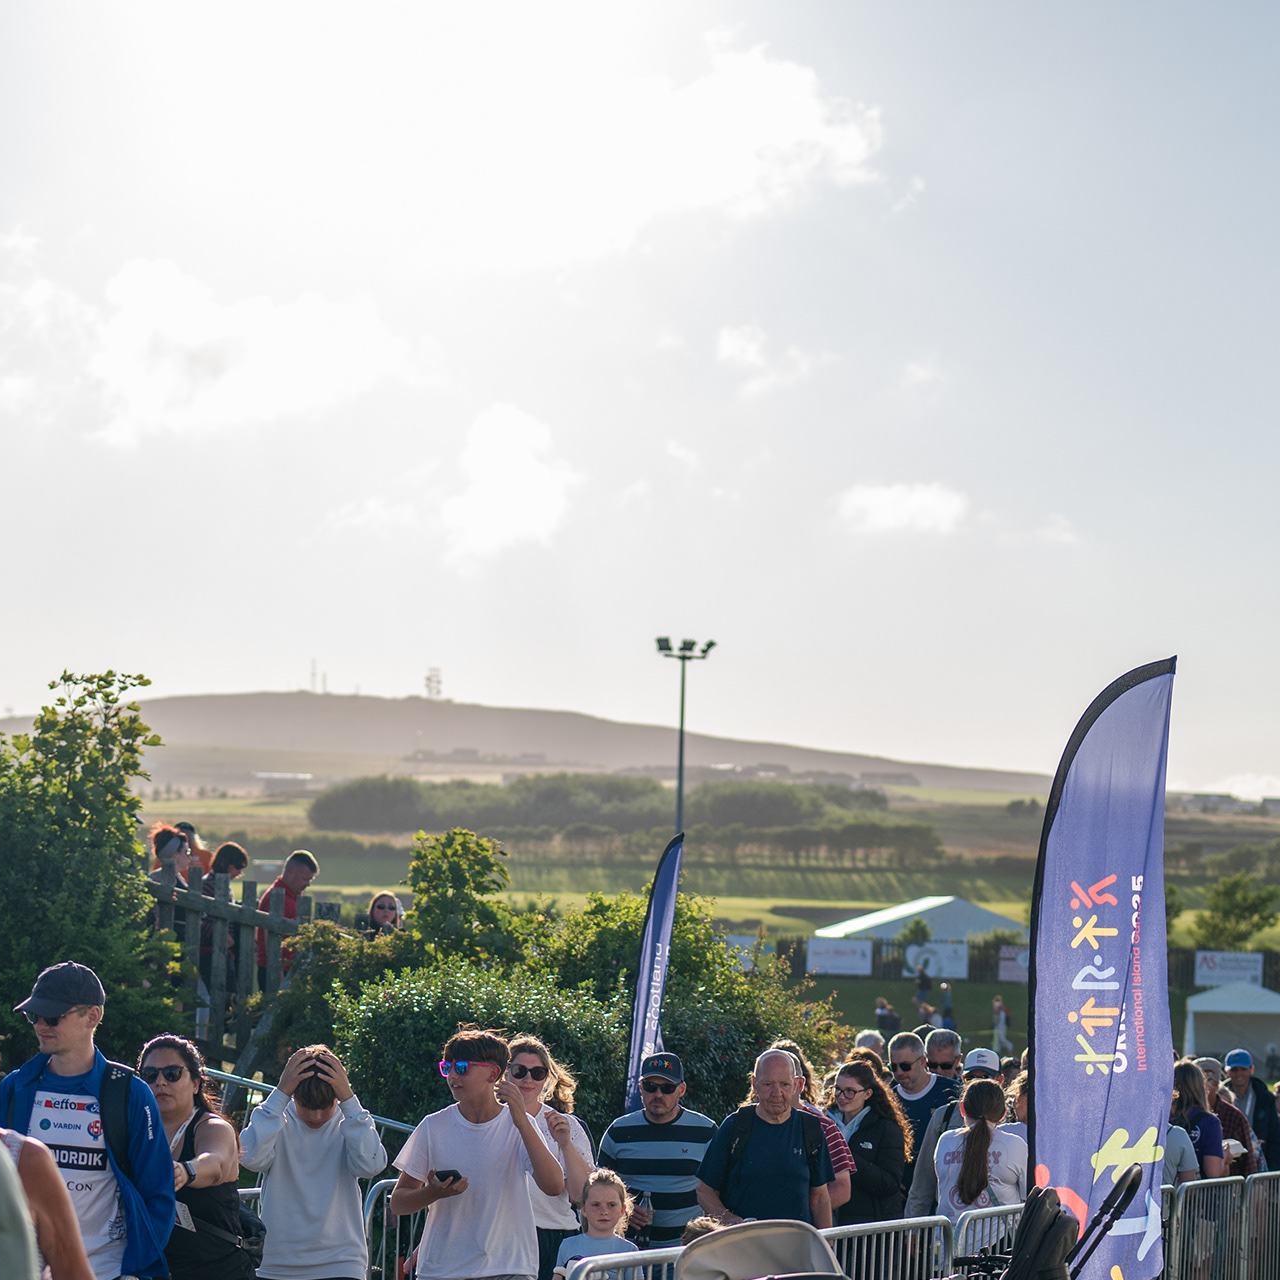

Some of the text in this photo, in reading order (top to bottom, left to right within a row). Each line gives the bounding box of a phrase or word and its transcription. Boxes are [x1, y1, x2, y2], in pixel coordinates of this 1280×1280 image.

[1131, 989, 1147, 1071] International
[53, 1098, 77, 1111] effo
[53, 1122, 82, 1131] VARDIN
[53, 1148, 104, 1167] NORDIK
